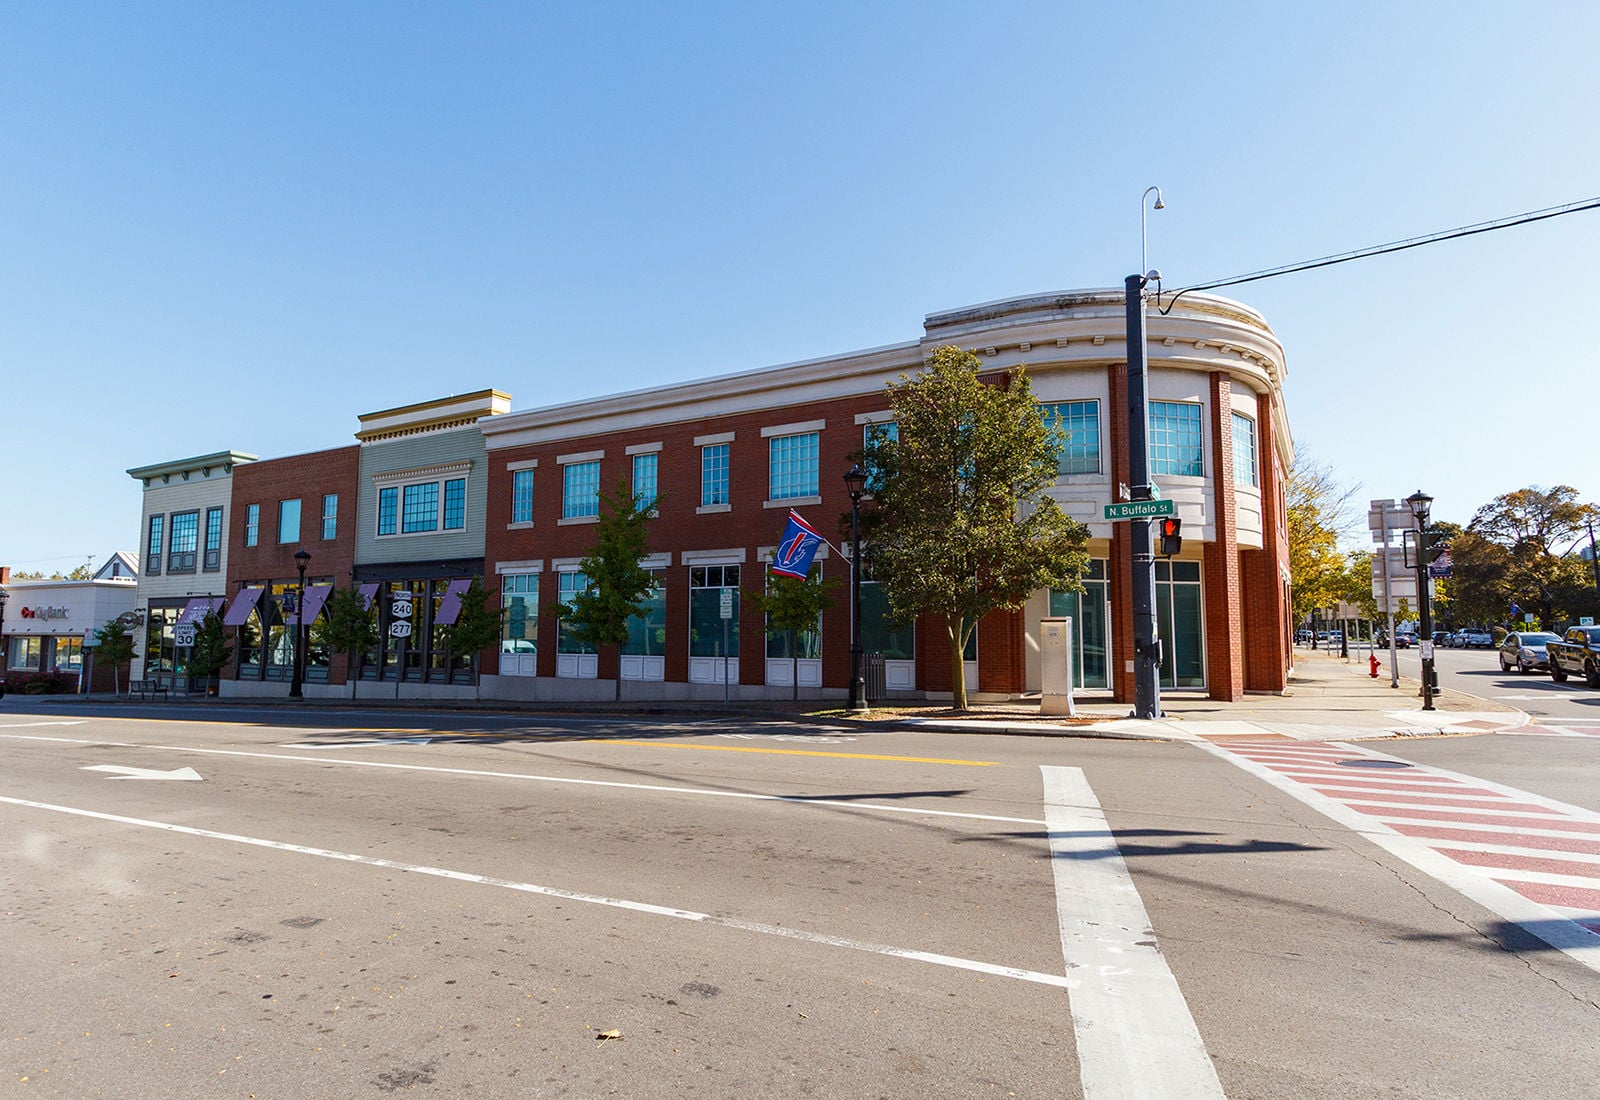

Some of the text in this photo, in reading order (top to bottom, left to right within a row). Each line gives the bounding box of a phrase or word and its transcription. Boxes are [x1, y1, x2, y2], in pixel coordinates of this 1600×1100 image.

[1121, 505, 1156, 515] Buffalo
[1159, 504, 1168, 512] St
[393, 604, 412, 614] 240
[392, 624, 411, 634] 277
[177, 635, 193, 645] 30
